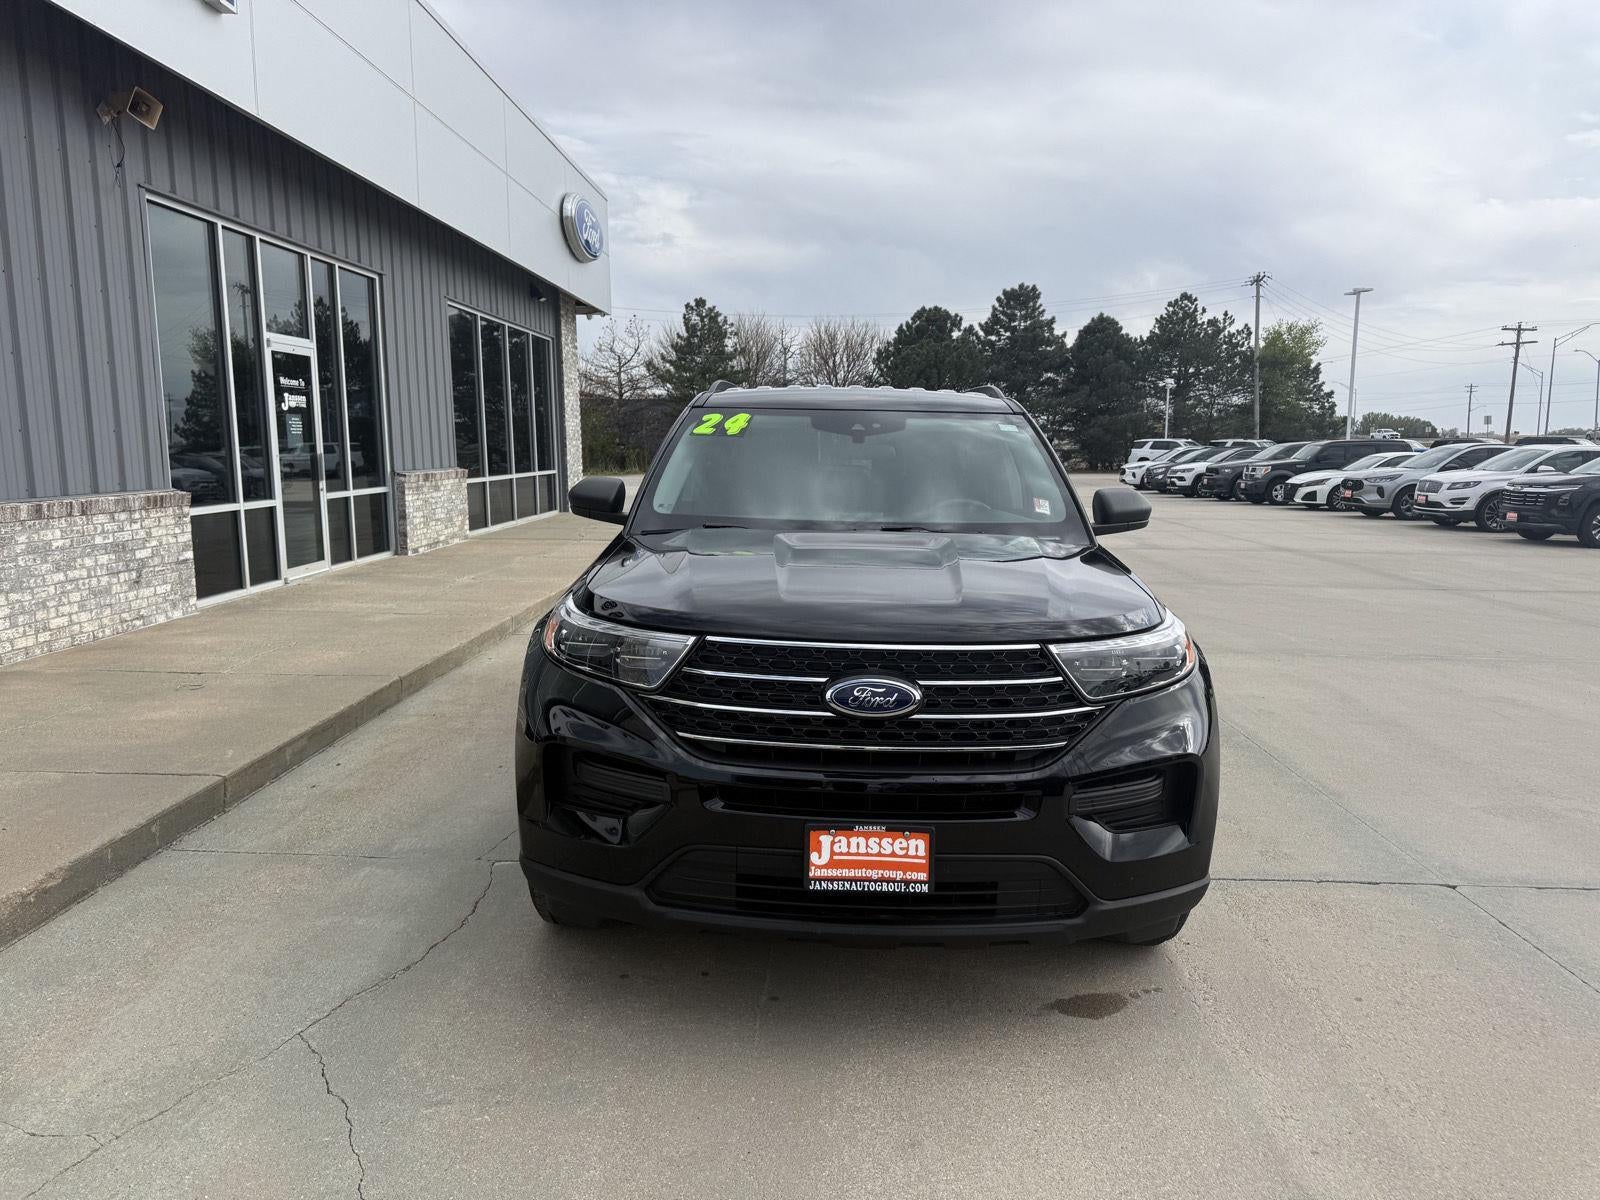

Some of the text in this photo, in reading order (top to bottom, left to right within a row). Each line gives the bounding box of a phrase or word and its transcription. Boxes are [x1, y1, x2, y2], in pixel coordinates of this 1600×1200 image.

[582, 208, 600, 250] Ford
[692, 412, 752, 436] 24
[848, 686, 899, 708] Ford
[810, 834, 927, 866] Janssen
[808, 866, 928, 881] Janssenautogroup.com
[809, 880, 929, 894] JANSSENAUTOGROUP.COM
